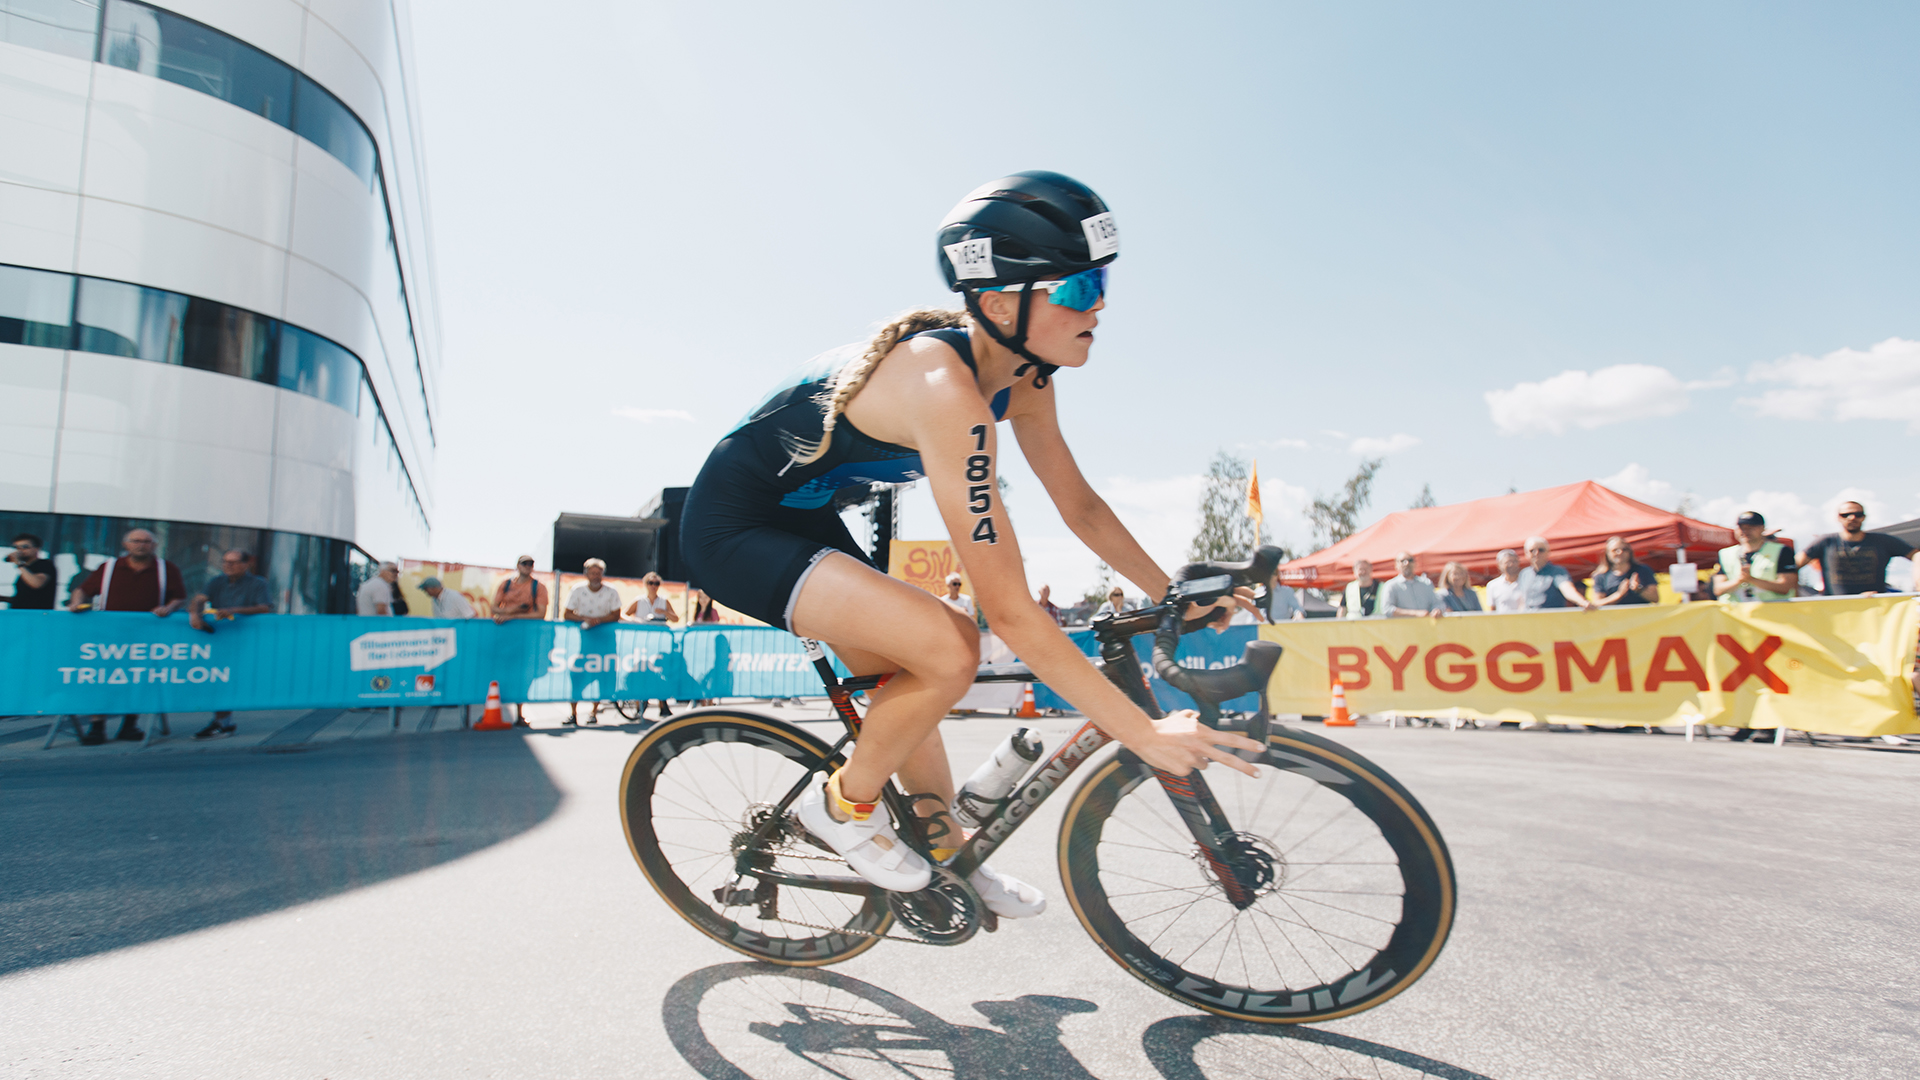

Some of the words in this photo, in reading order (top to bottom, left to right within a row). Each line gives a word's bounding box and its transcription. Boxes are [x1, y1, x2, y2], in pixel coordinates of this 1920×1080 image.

[964, 423, 998, 546] 1854
[79, 642, 212, 661] SWEDEN
[547, 647, 664, 673] Scandic
[727, 652, 811, 672] TRIMTEX
[1327, 633, 1790, 695] BYGGMAX
[57, 665, 231, 685] TRIATHLON
[973, 757, 1070, 863] ARGON
[1063, 727, 1104, 760] 18
